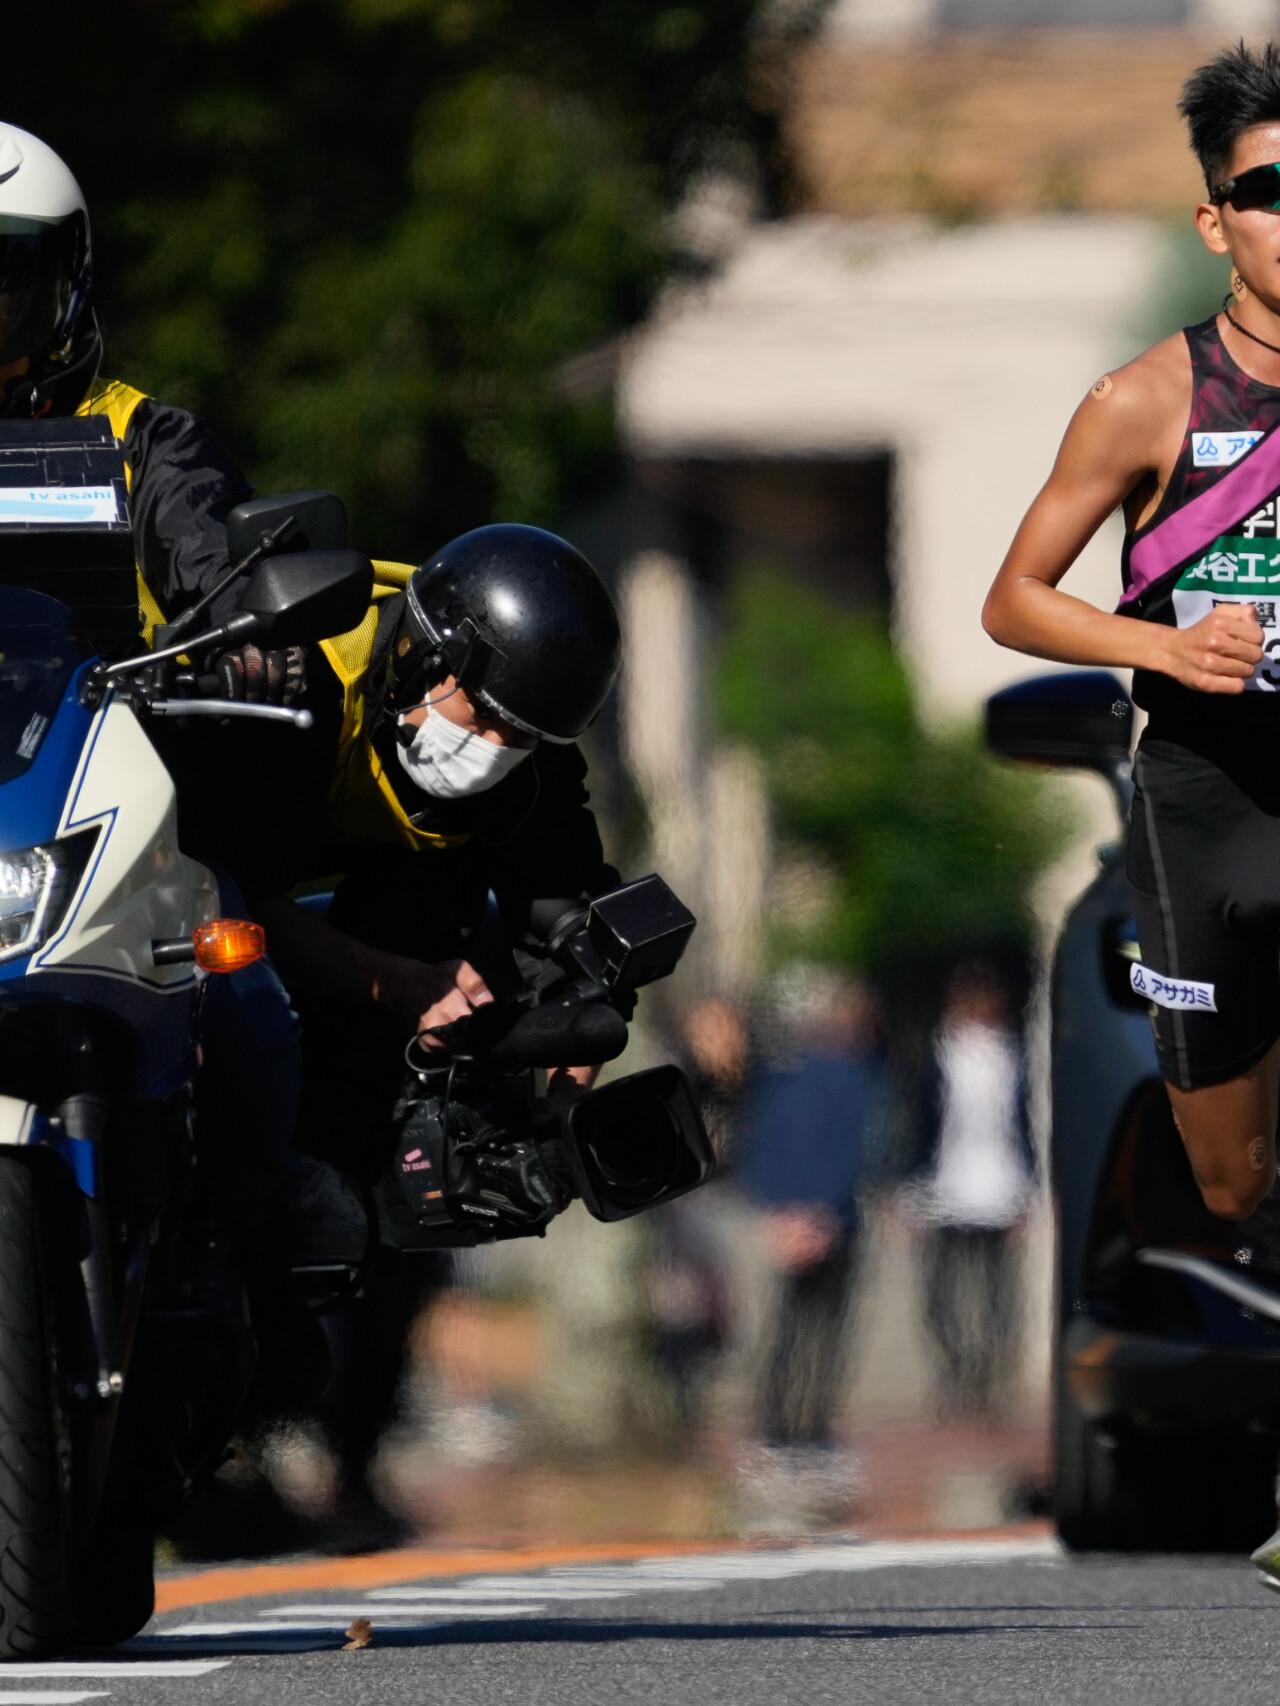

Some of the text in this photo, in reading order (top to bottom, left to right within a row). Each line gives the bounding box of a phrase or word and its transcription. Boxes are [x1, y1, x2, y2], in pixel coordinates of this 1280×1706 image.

[29, 490, 112, 500] tv asahi
[1151, 977, 1212, 1007] アサガミ
